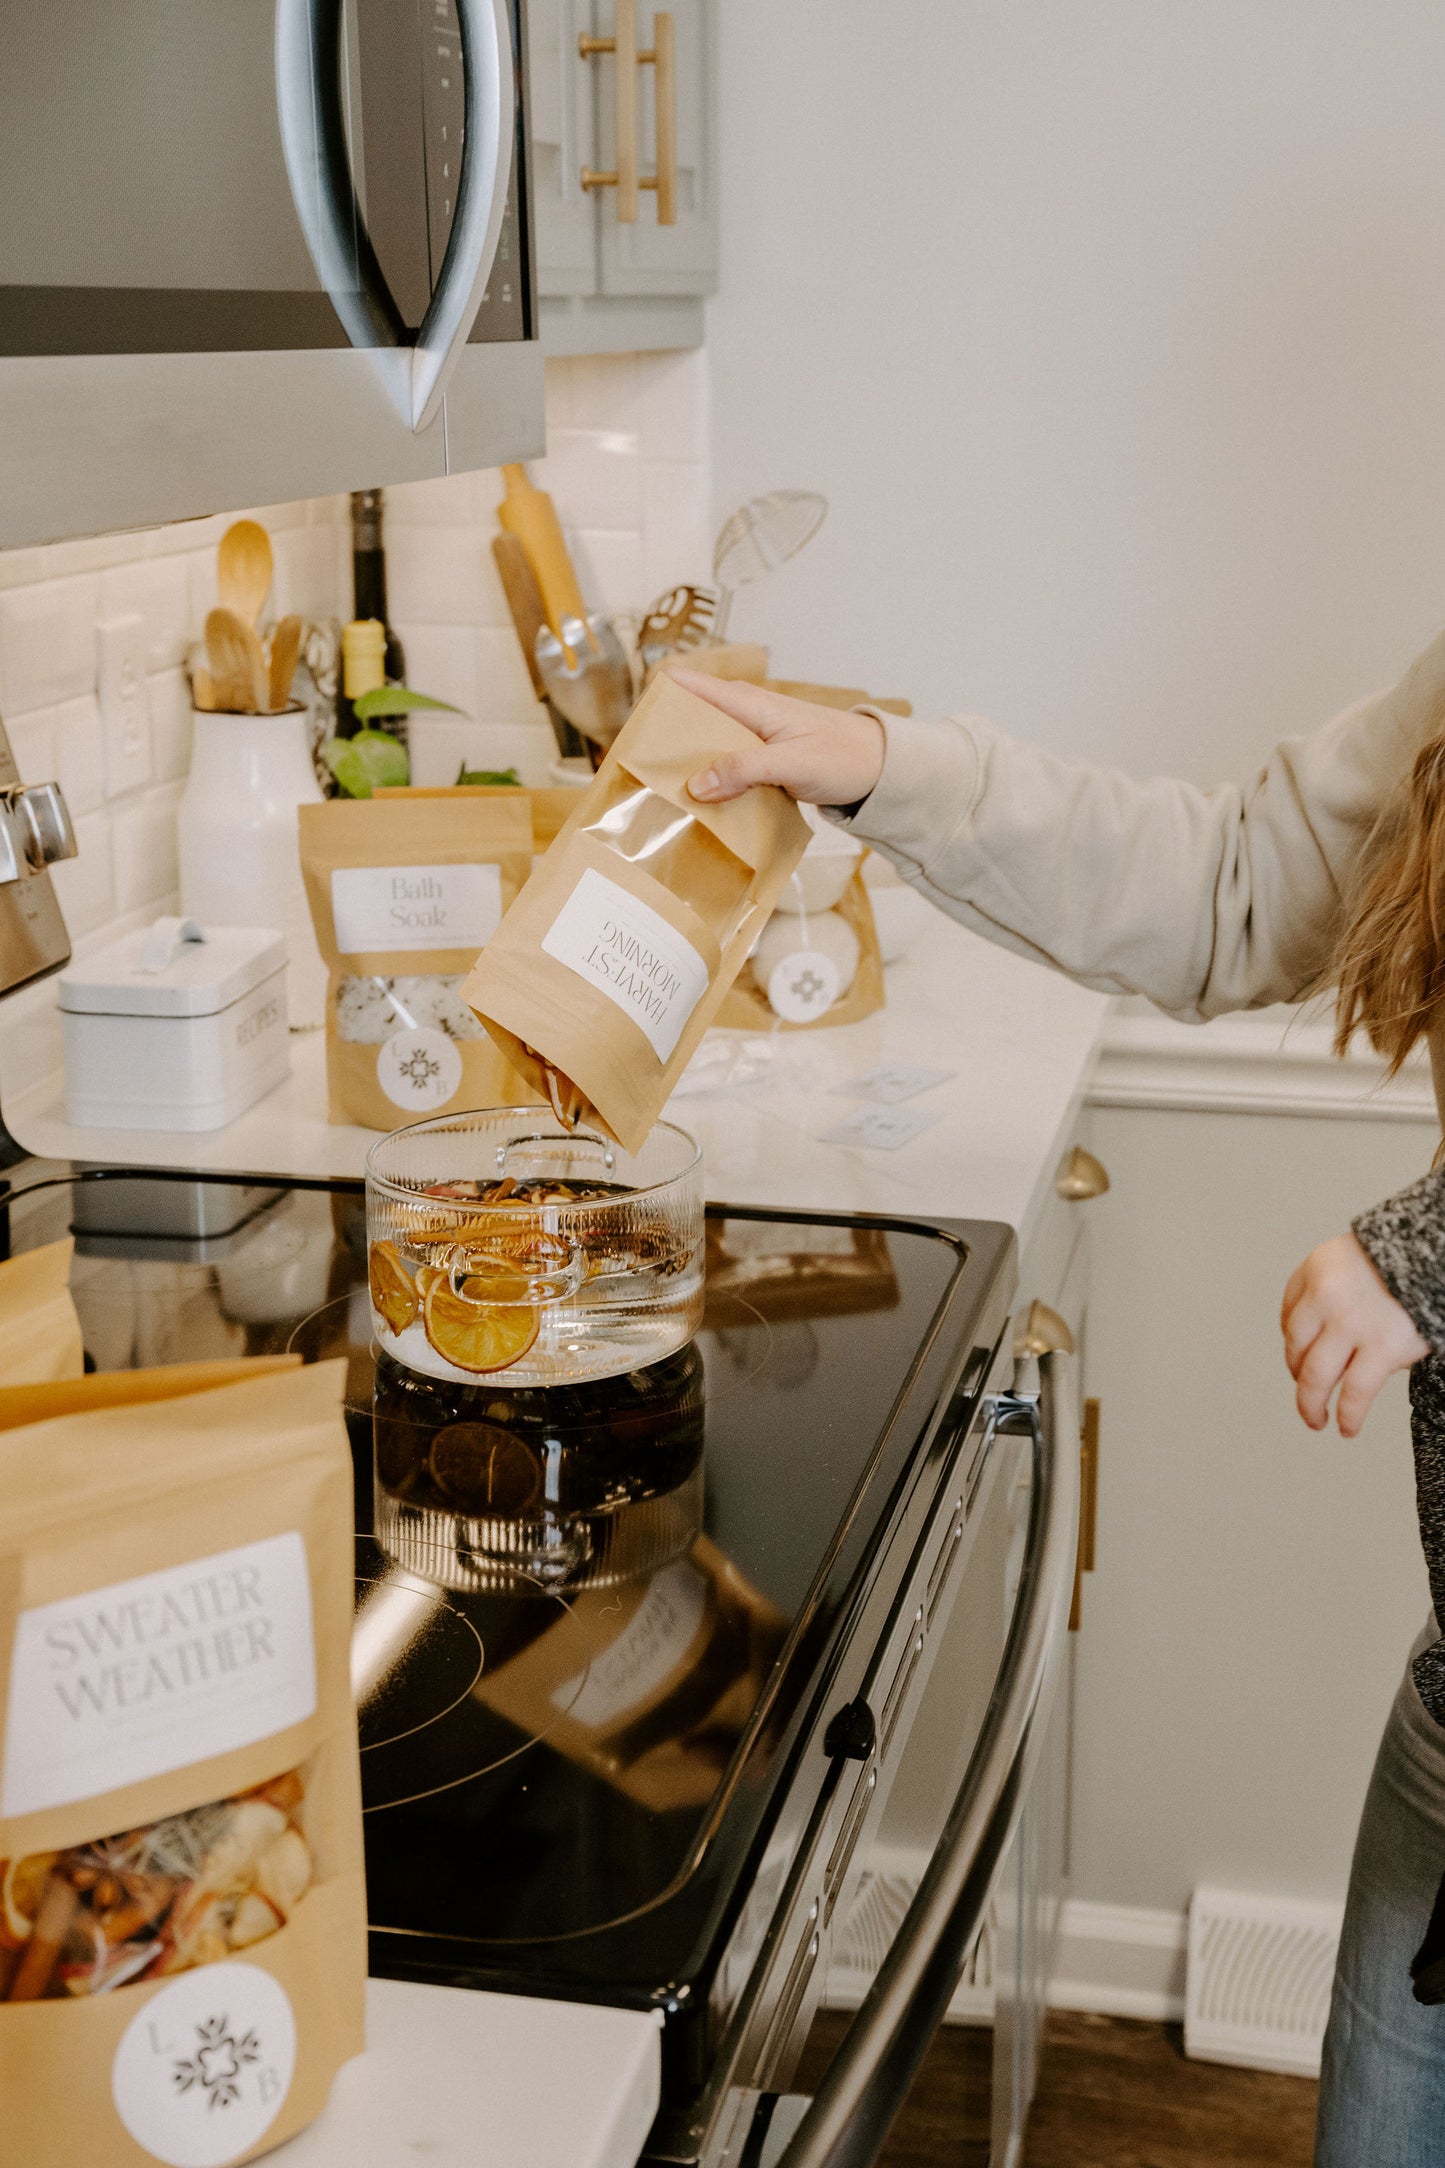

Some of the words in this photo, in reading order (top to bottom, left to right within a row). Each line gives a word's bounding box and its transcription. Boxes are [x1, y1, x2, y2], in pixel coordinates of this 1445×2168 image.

[390, 905, 447, 930] Soak
[391, 876, 443, 901] Bath
[583, 944, 669, 1026] HARVEST
[599, 921, 681, 1001] MORNING
[43, 1563, 264, 1672] SWEATER
[53, 1615, 276, 1722] WEATHER
